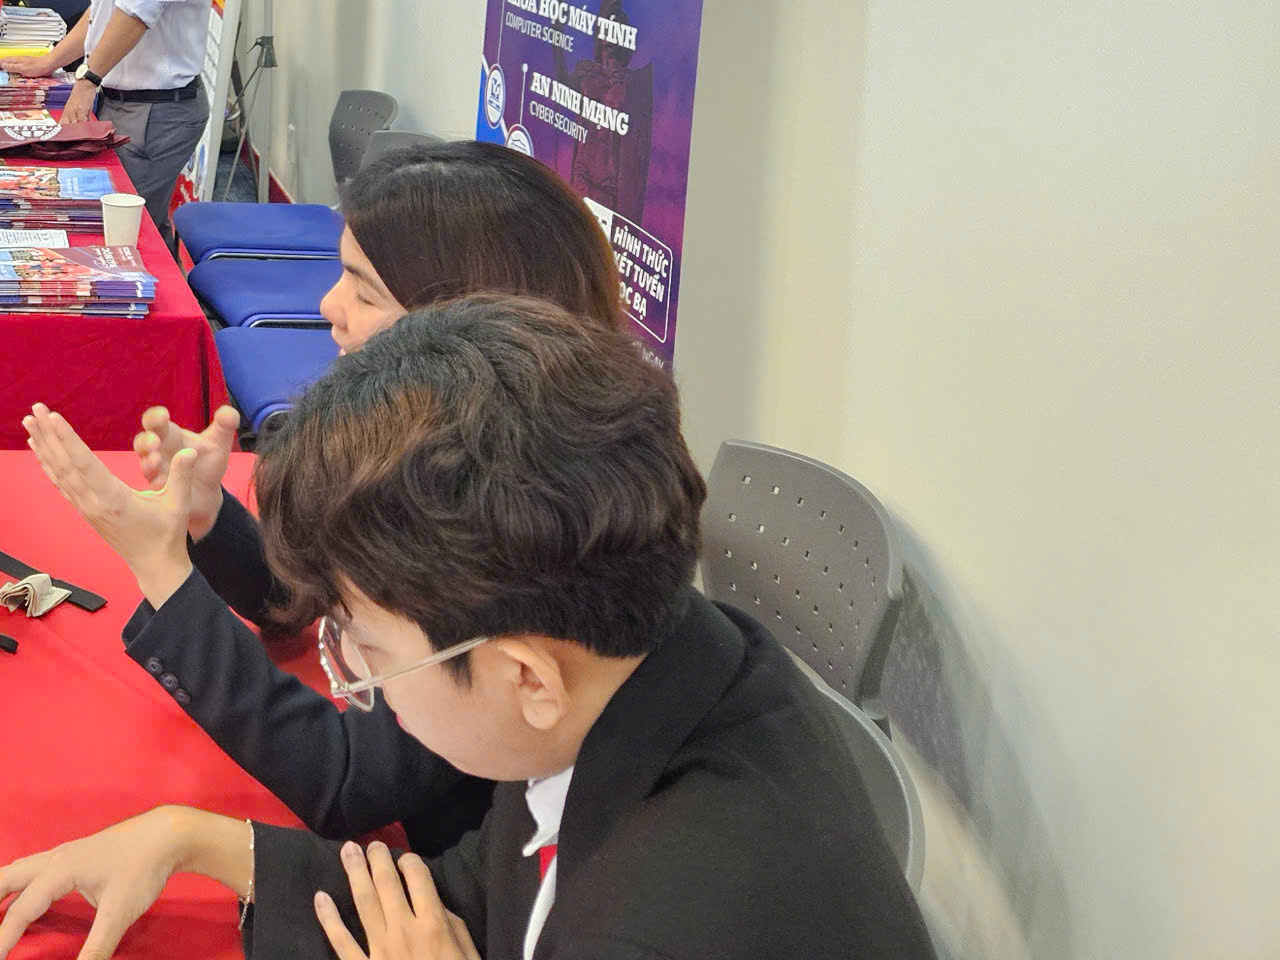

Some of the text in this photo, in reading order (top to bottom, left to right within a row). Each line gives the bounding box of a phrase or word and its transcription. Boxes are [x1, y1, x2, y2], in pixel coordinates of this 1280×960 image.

[505, 11, 574, 53] COMPUTER SCIENCE
[569, 4, 597, 36] MÁY
[597, 14, 638, 51] TÍNH
[529, 71, 629, 137] AN NINH MẠNG
[529, 101, 588, 144] CYBER SECURITY
[613, 225, 669, 278] HÌNH THỨC
[633, 264, 665, 303] TUYỂN
[632, 291, 647, 321] BẠ
